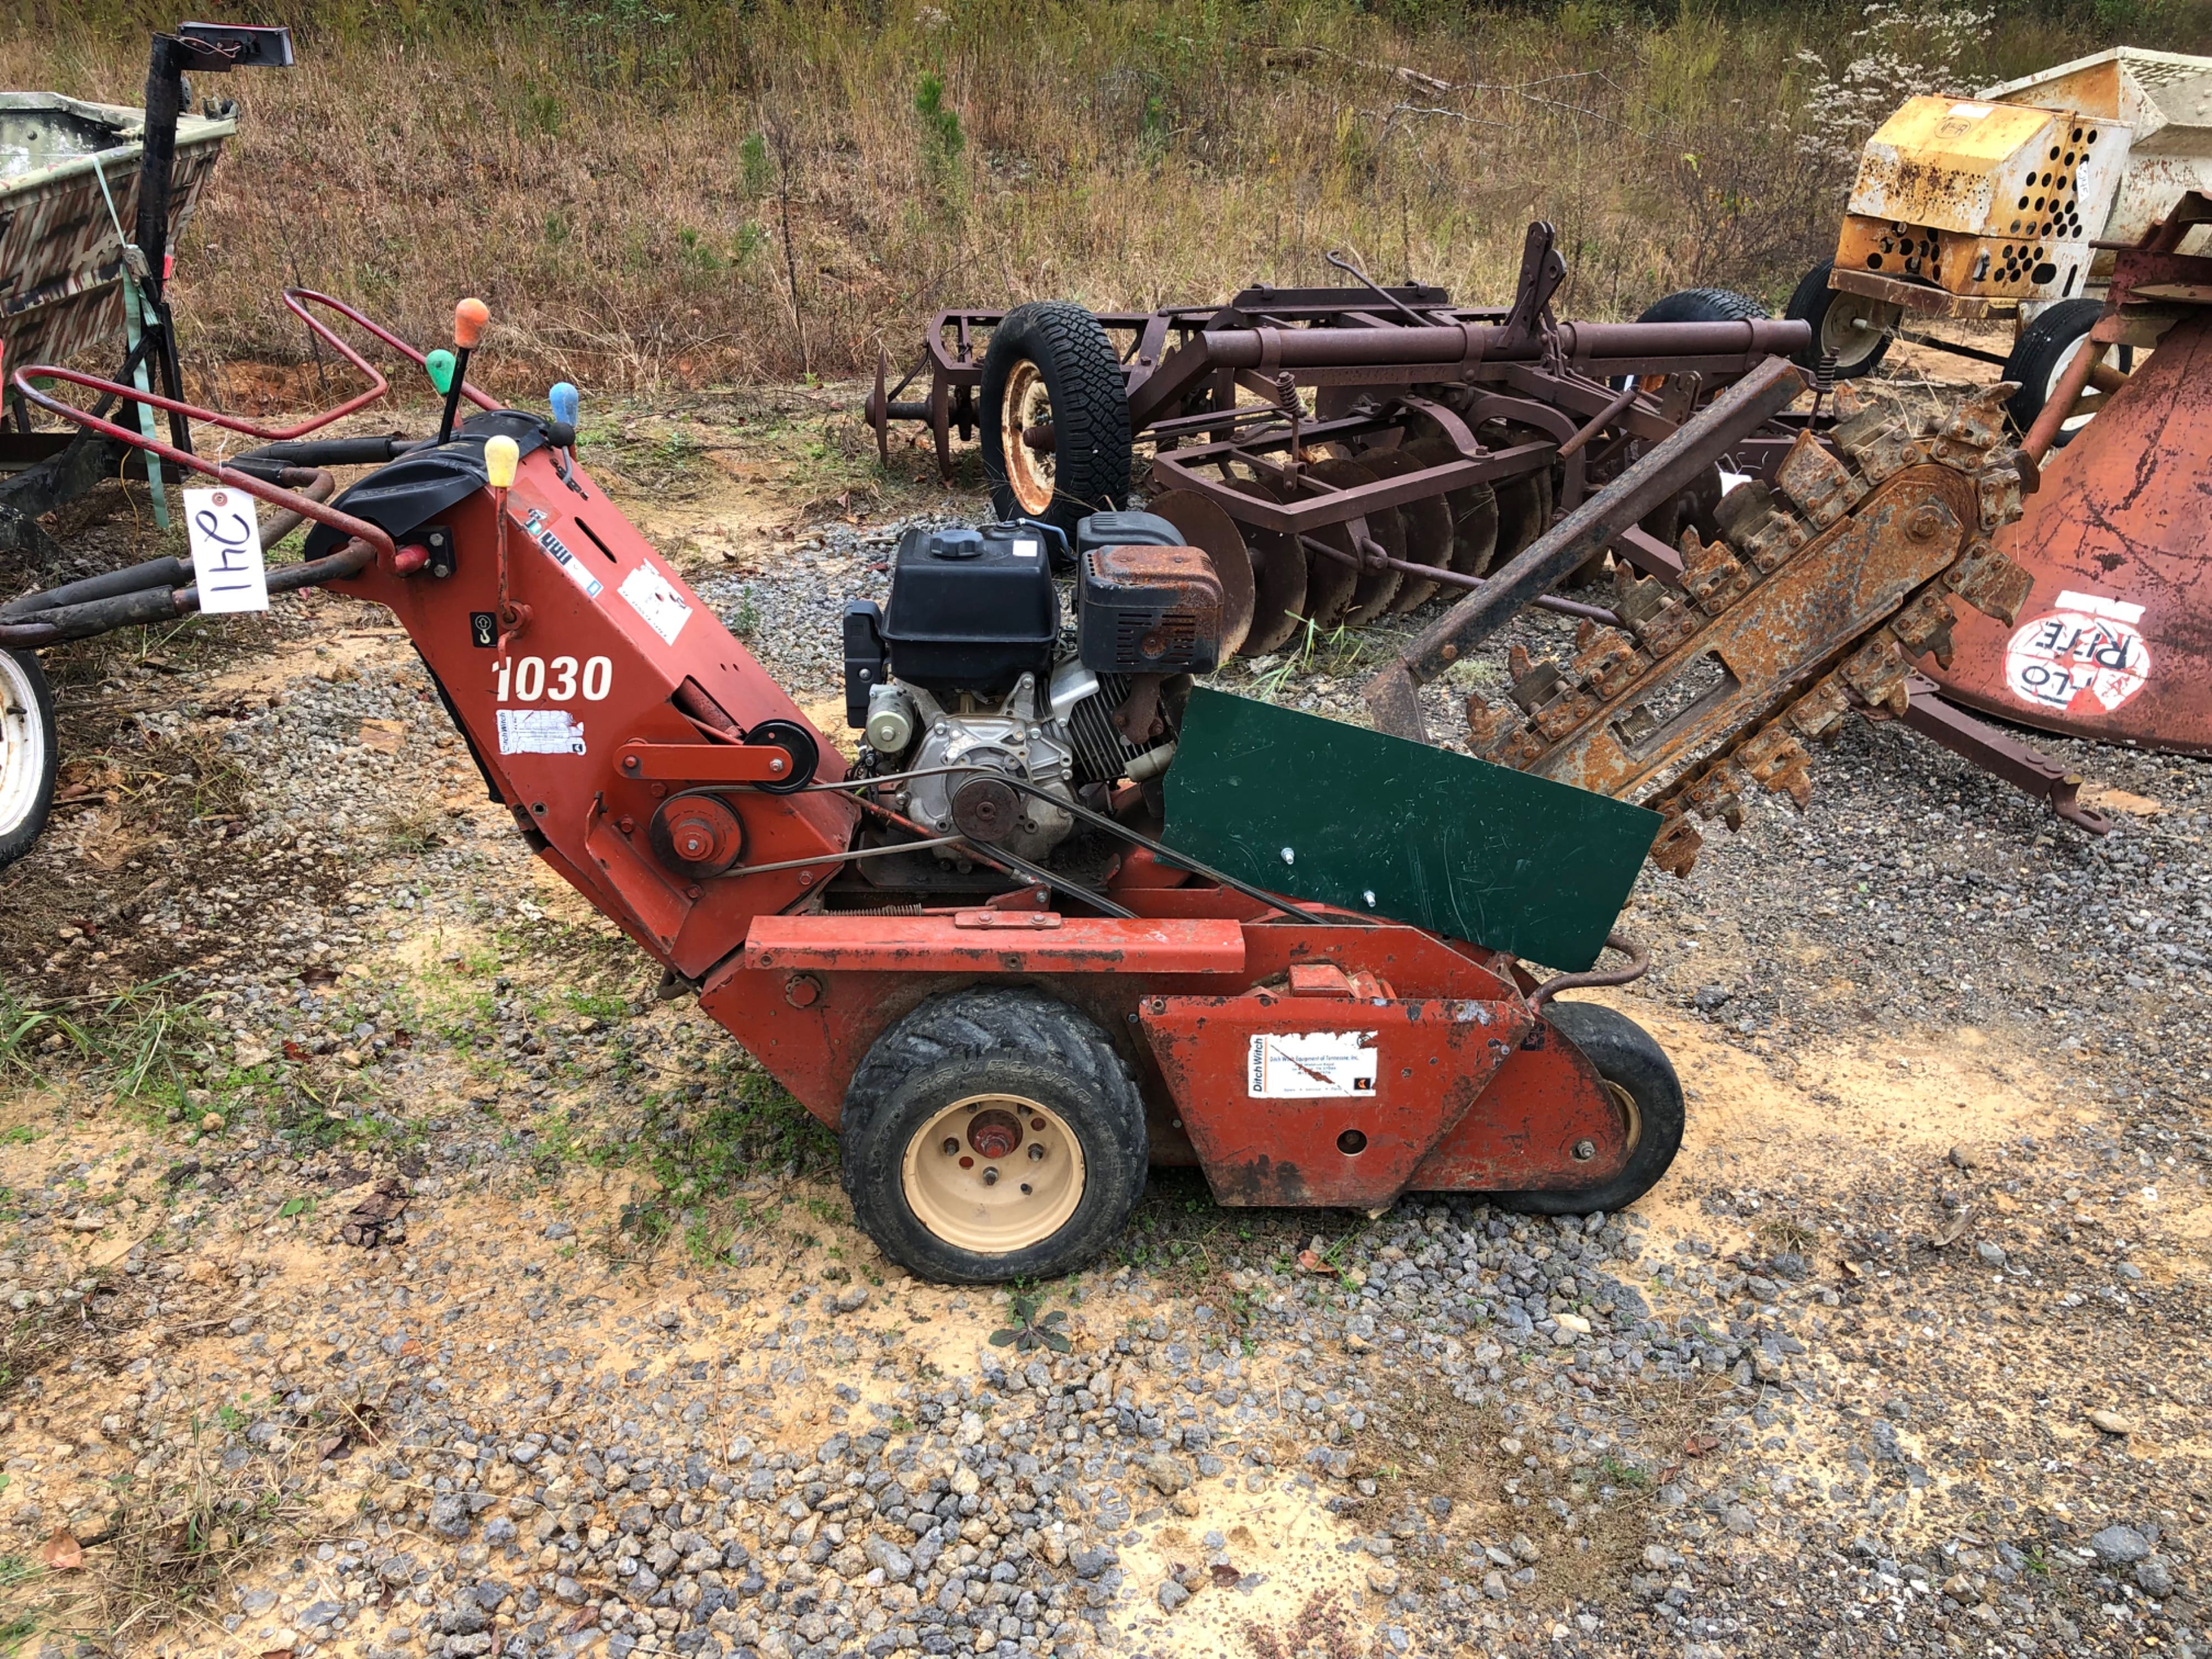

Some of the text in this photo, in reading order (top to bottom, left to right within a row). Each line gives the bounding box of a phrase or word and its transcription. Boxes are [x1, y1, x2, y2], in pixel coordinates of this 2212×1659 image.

[195, 509, 252, 592] 241
[492, 655, 612, 702] 1030
[984, 1059, 1093, 1104] POWER
[1253, 1037, 1263, 1092] Ditch Witch
